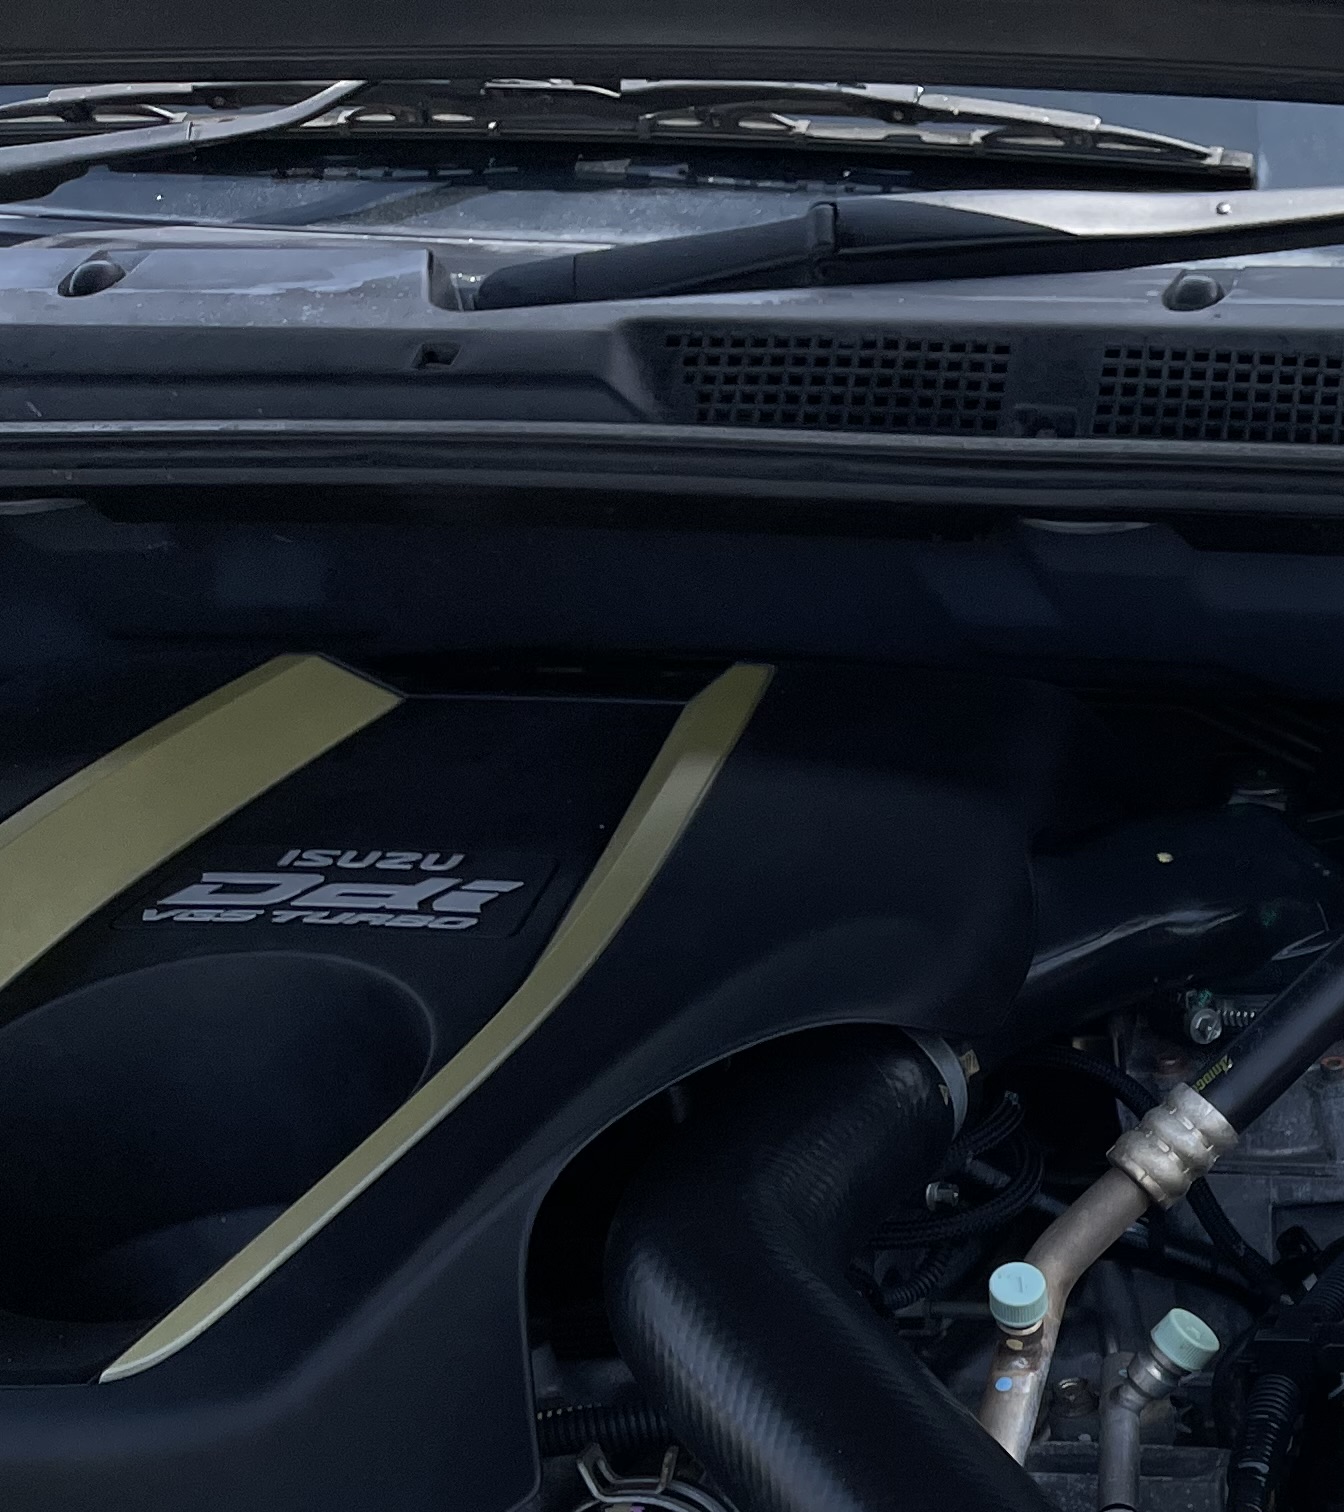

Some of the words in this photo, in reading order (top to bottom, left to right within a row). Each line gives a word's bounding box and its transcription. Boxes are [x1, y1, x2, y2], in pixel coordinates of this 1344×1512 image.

[277, 849, 464, 871] ISUZU
[142, 908, 264, 922] VGS
[272, 910, 479, 929] TURBO
